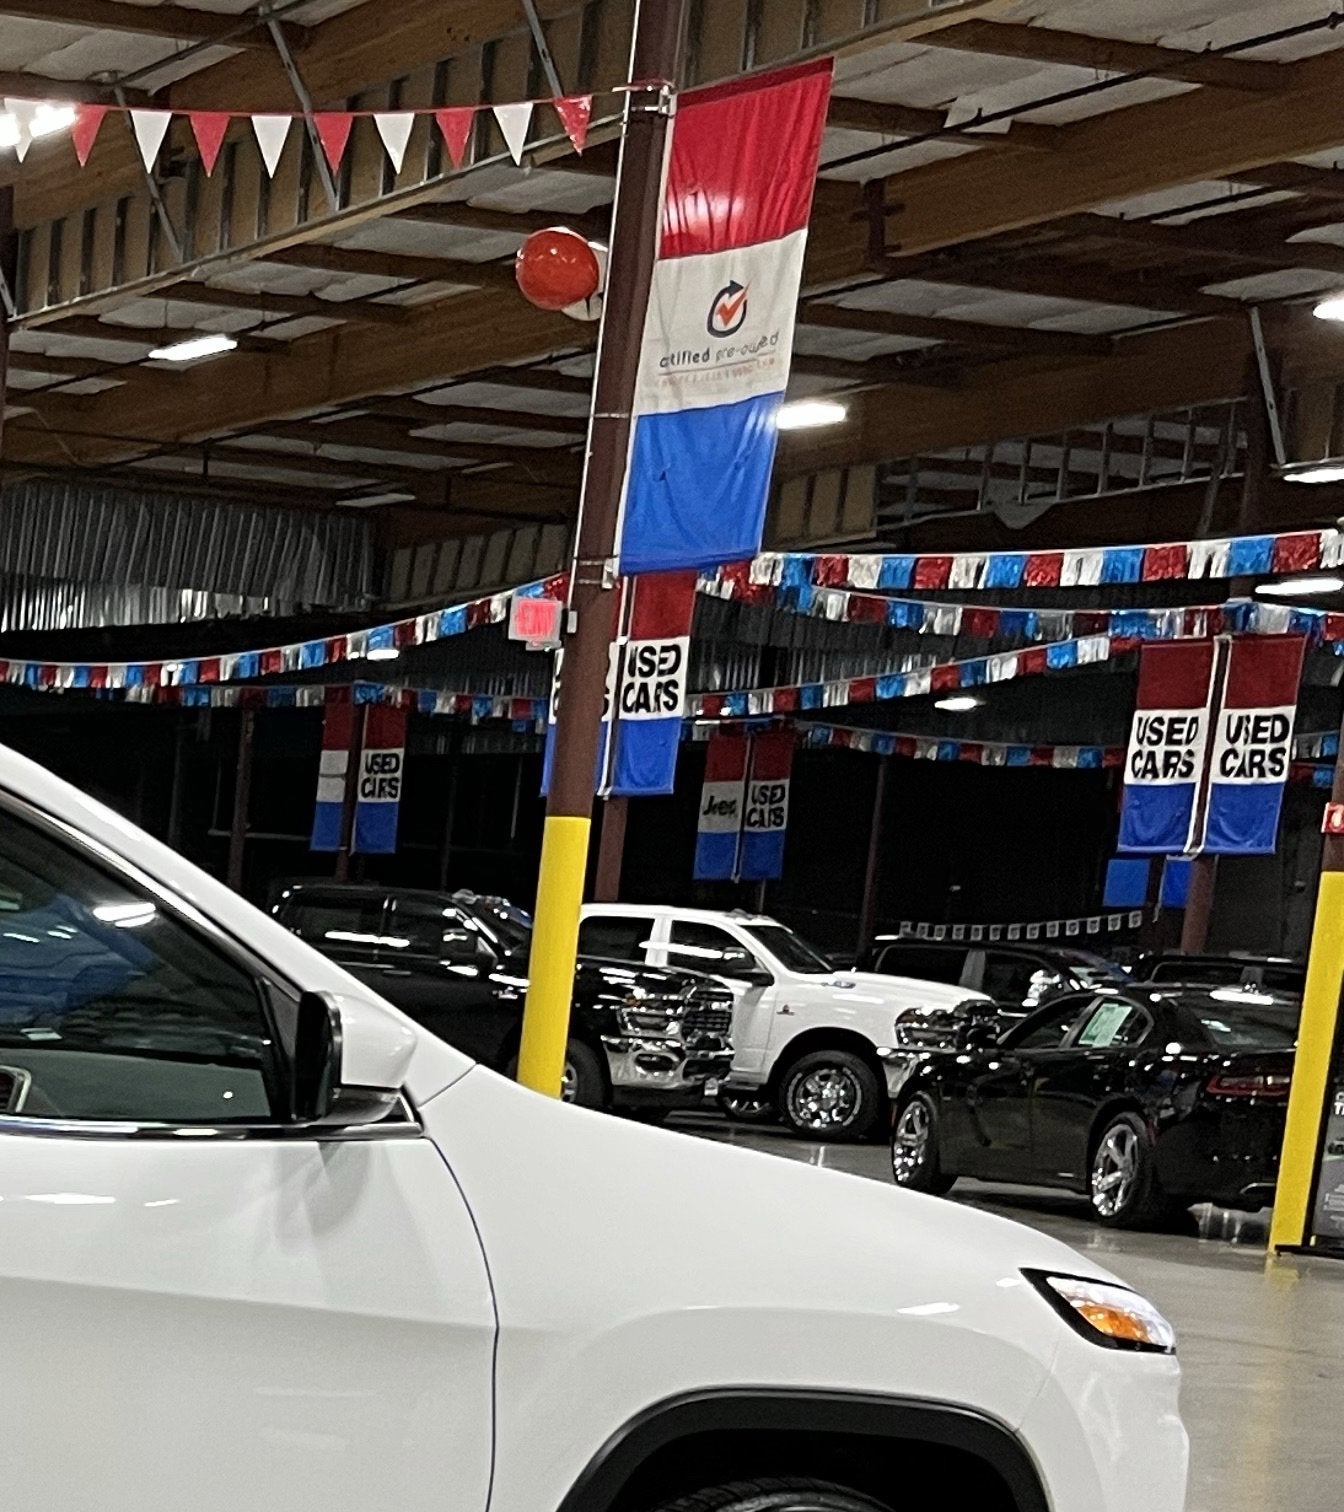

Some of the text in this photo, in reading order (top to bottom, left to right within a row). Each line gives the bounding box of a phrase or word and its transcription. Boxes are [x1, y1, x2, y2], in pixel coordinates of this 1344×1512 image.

[659, 347, 711, 369] ctified
[627, 644, 682, 678] USED
[622, 679, 679, 713] CARS
[1136, 715, 1199, 746] USED
[1225, 713, 1291, 745] USED
[365, 753, 400, 775] USED
[1130, 748, 1195, 779] CARS
[1219, 747, 1287, 778] CARS
[751, 784, 786, 806] USED
